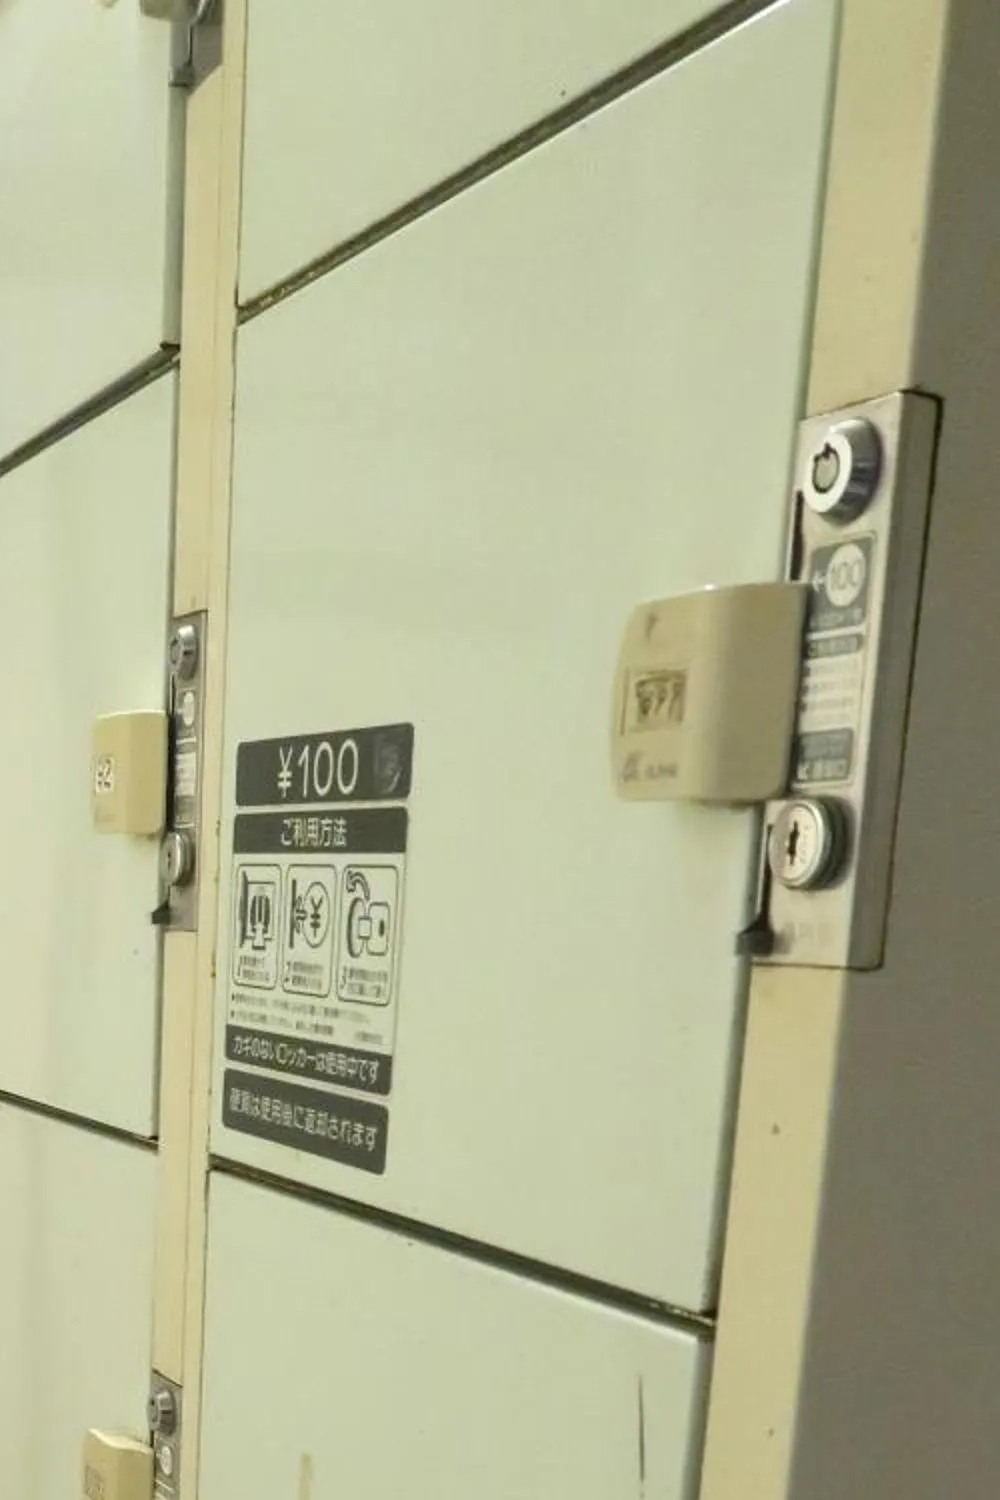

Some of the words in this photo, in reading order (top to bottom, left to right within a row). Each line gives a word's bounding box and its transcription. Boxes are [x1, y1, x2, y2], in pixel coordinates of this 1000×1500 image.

[277, 738, 359, 799] ¥100
[280, 817, 348, 848] ご利用方法
